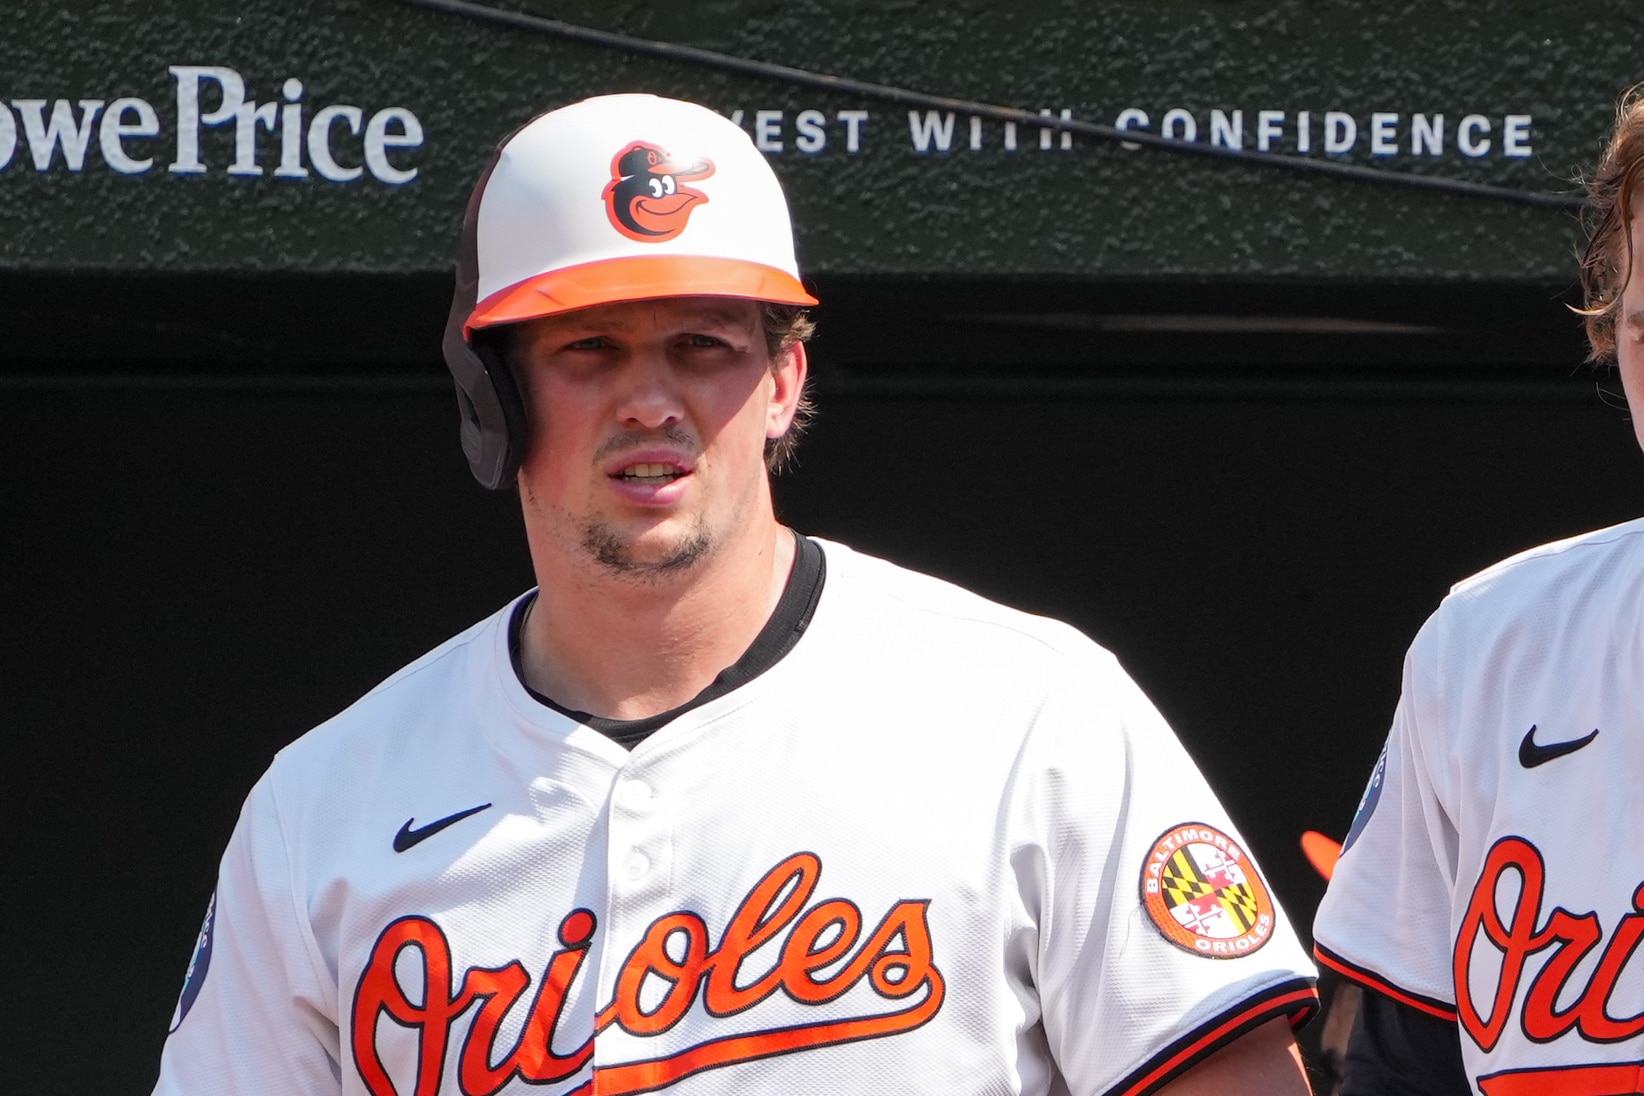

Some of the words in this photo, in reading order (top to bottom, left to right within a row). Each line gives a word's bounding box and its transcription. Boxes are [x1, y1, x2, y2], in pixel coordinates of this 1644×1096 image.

[1115, 107, 1533, 158] CONFIDENCE
[1146, 828, 1242, 894] BALTIMORE
[1195, 914, 1270, 953] ORIOLES
